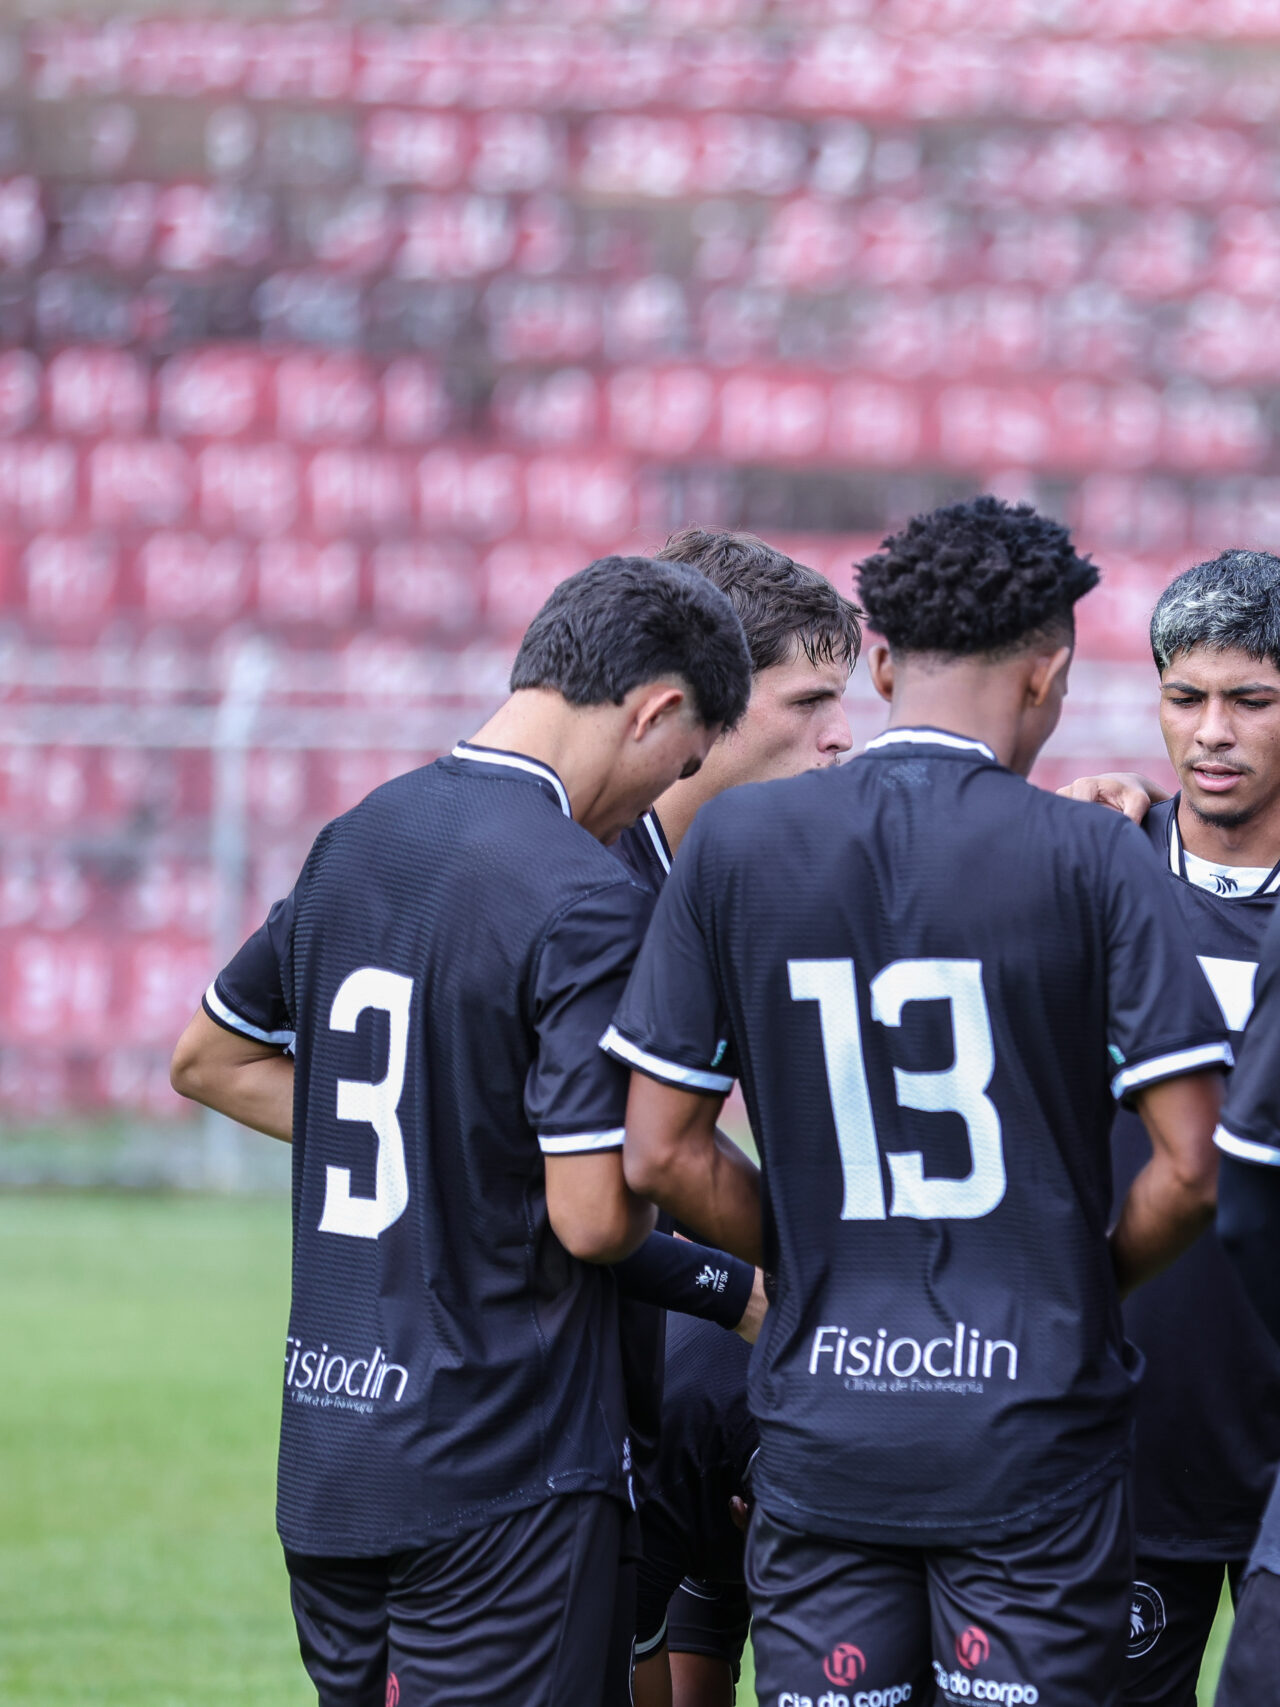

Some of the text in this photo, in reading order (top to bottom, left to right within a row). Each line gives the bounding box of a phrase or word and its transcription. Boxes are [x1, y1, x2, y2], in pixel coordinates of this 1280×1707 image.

[317, 967, 414, 1241] 3
[787, 957, 1007, 1221] 13
[808, 1321, 1019, 1380] Fisioclin
[778, 1683, 912, 1707] Cia do corpo
[949, 1670, 971, 1697] do
[972, 1678, 1039, 1707] corpo
